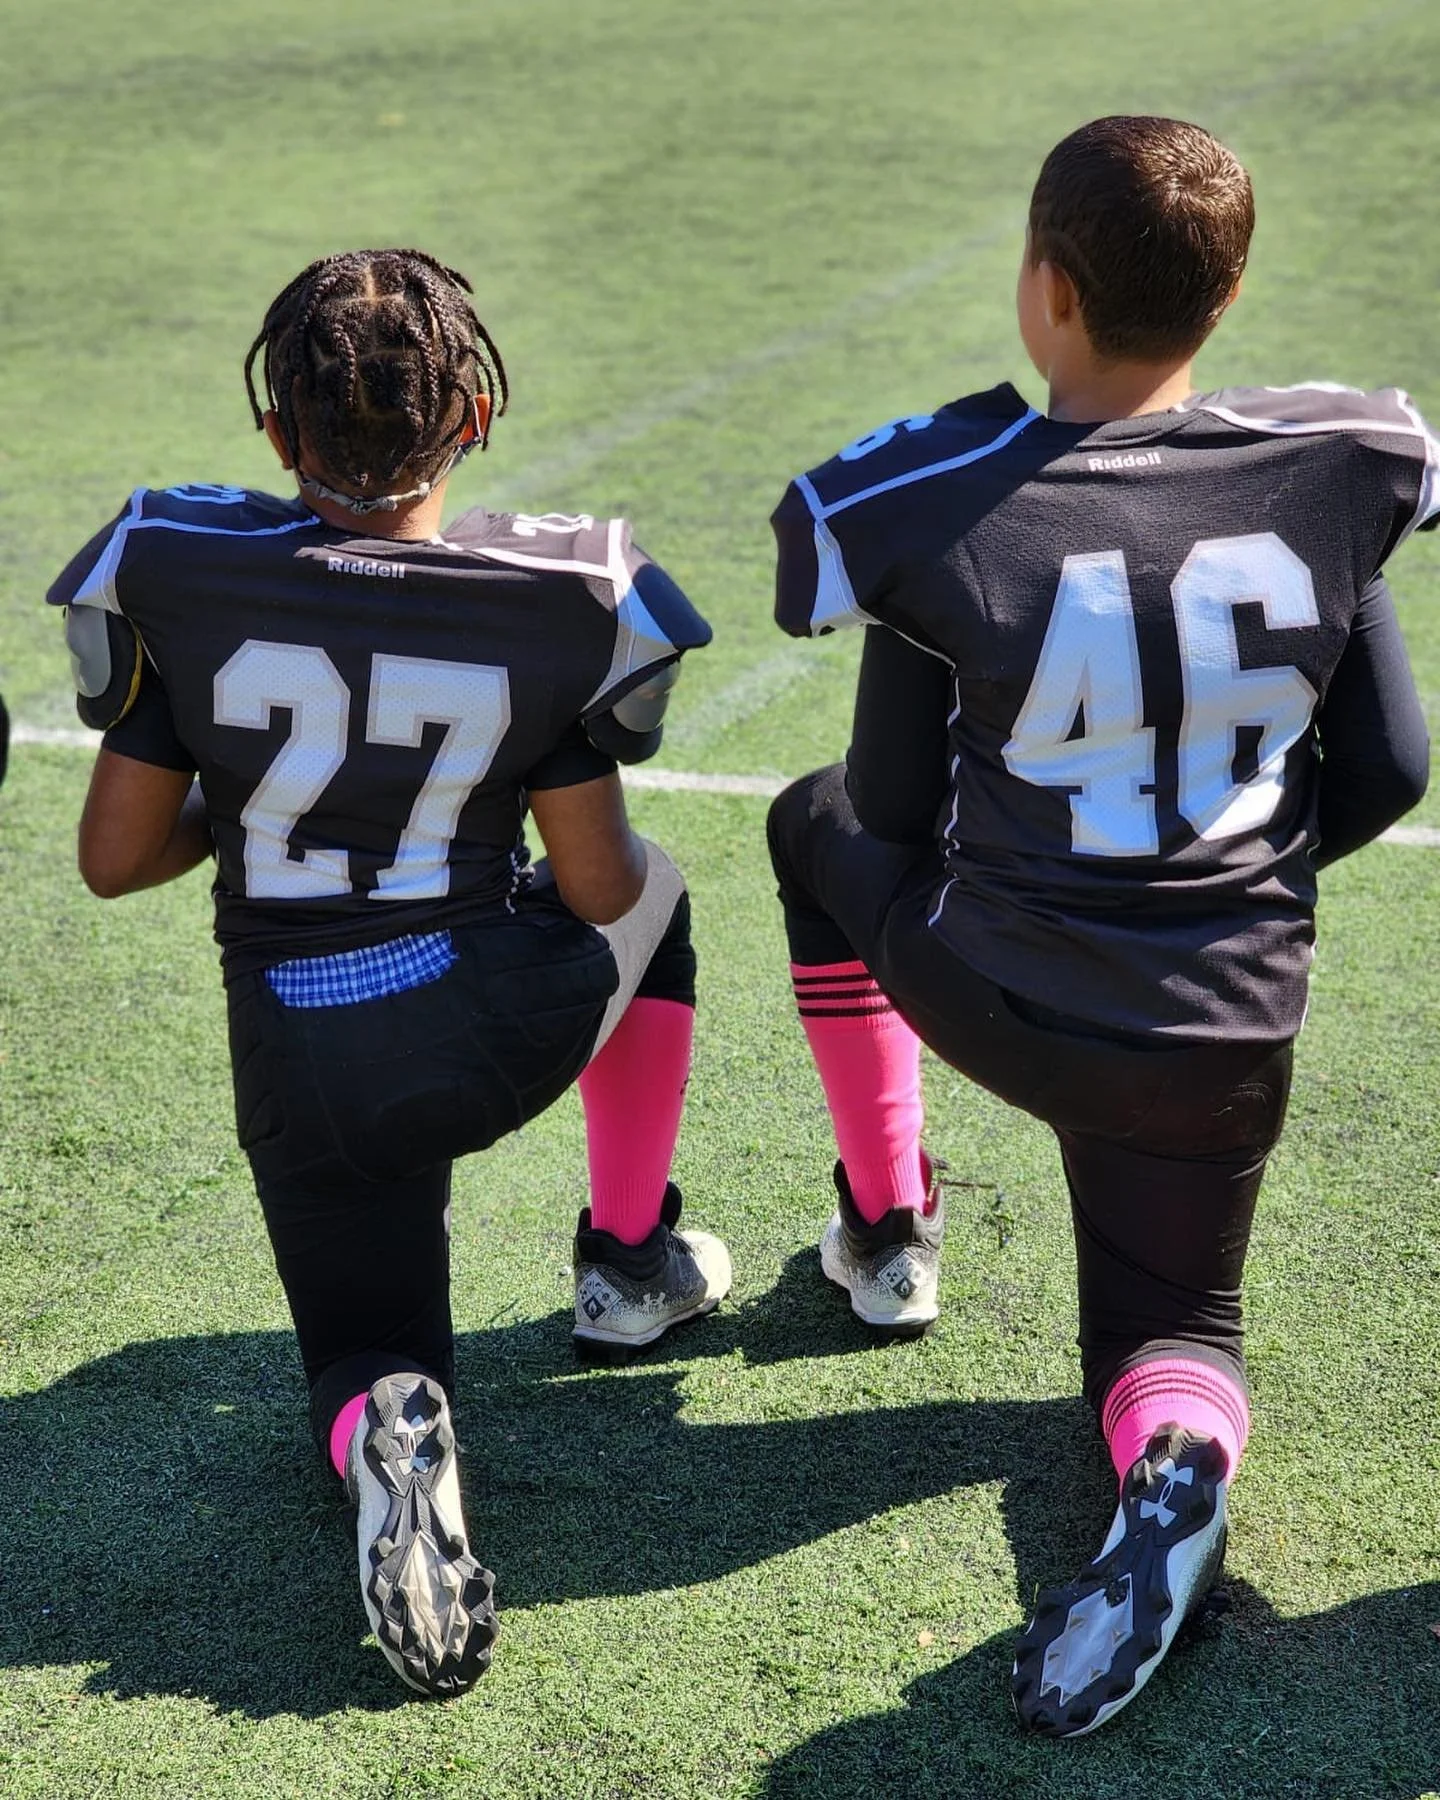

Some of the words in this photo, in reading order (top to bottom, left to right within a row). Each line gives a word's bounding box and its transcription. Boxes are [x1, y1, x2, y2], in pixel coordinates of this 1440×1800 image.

[1087, 452, 1162, 472] Riddell
[327, 557, 405, 579] Riddell
[1001, 531, 1321, 857] 46
[213, 639, 512, 900] 27
